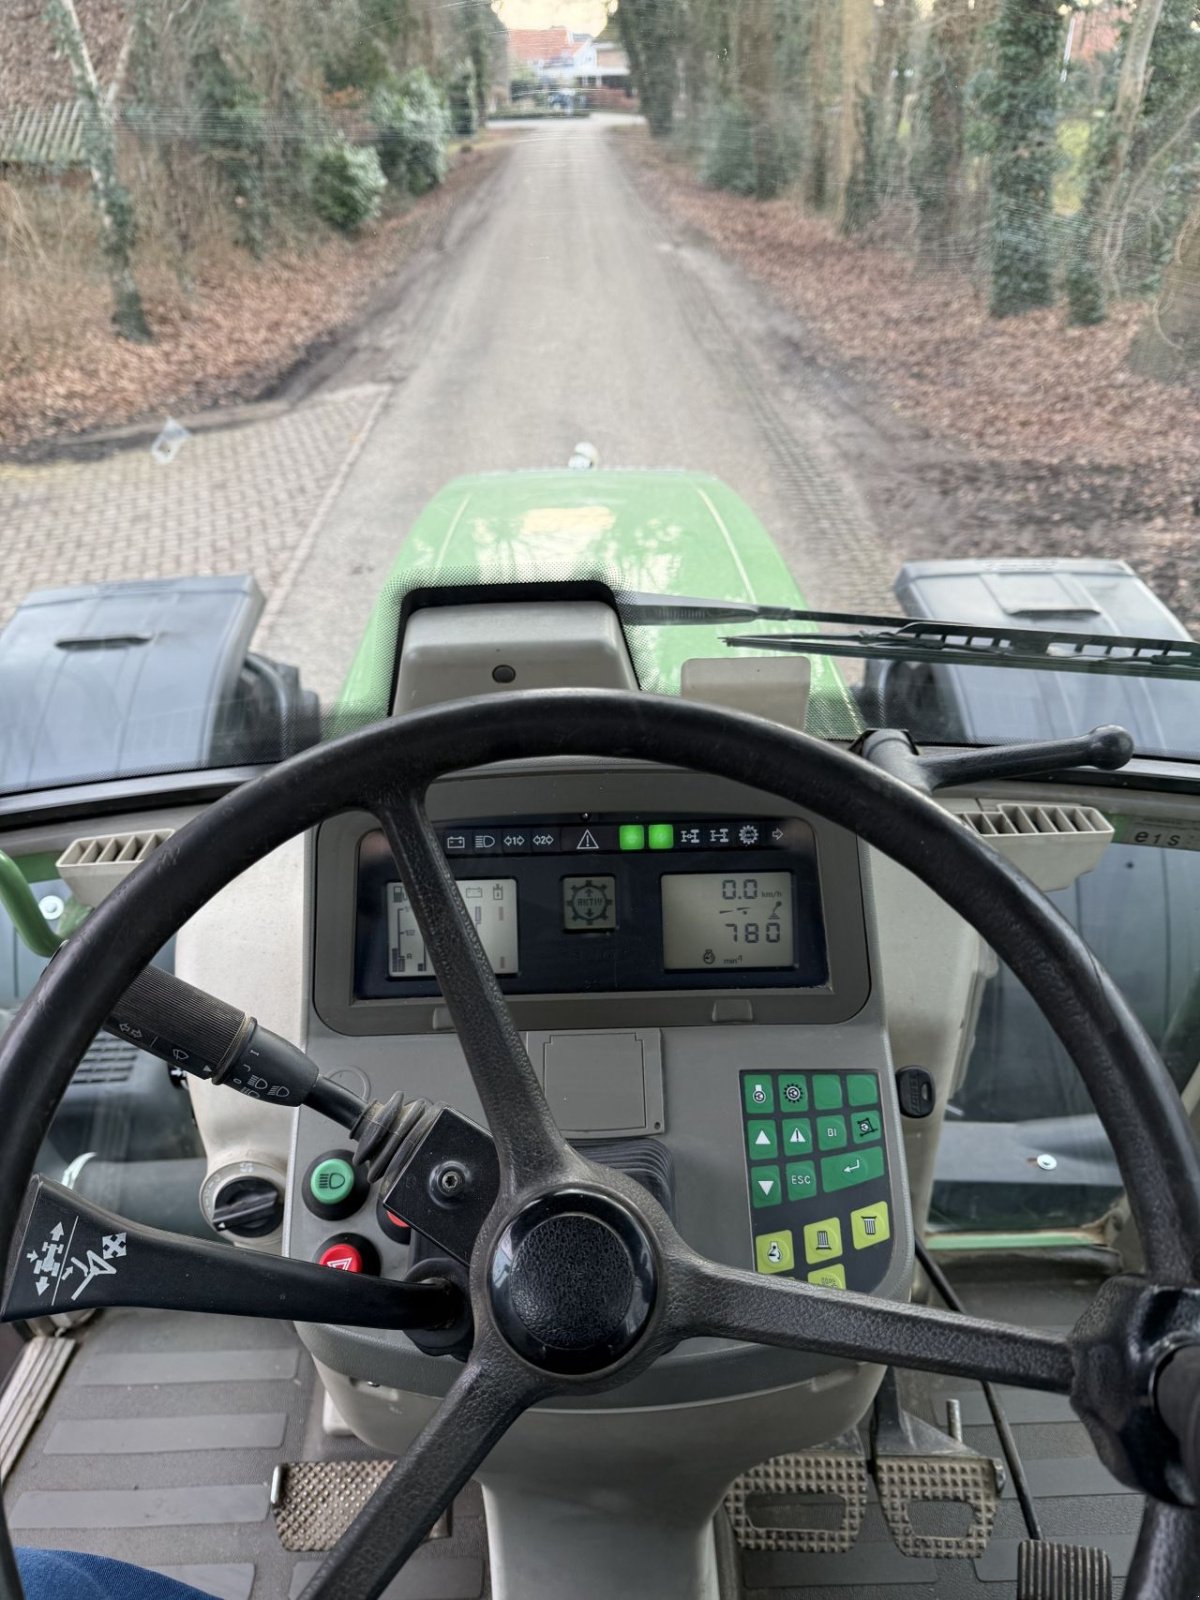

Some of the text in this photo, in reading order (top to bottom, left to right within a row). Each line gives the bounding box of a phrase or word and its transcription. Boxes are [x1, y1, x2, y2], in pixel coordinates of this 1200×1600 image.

[722, 879, 758, 900] 0.0
[725, 923, 780, 943] 780
[791, 1174, 811, 1185] ESC
